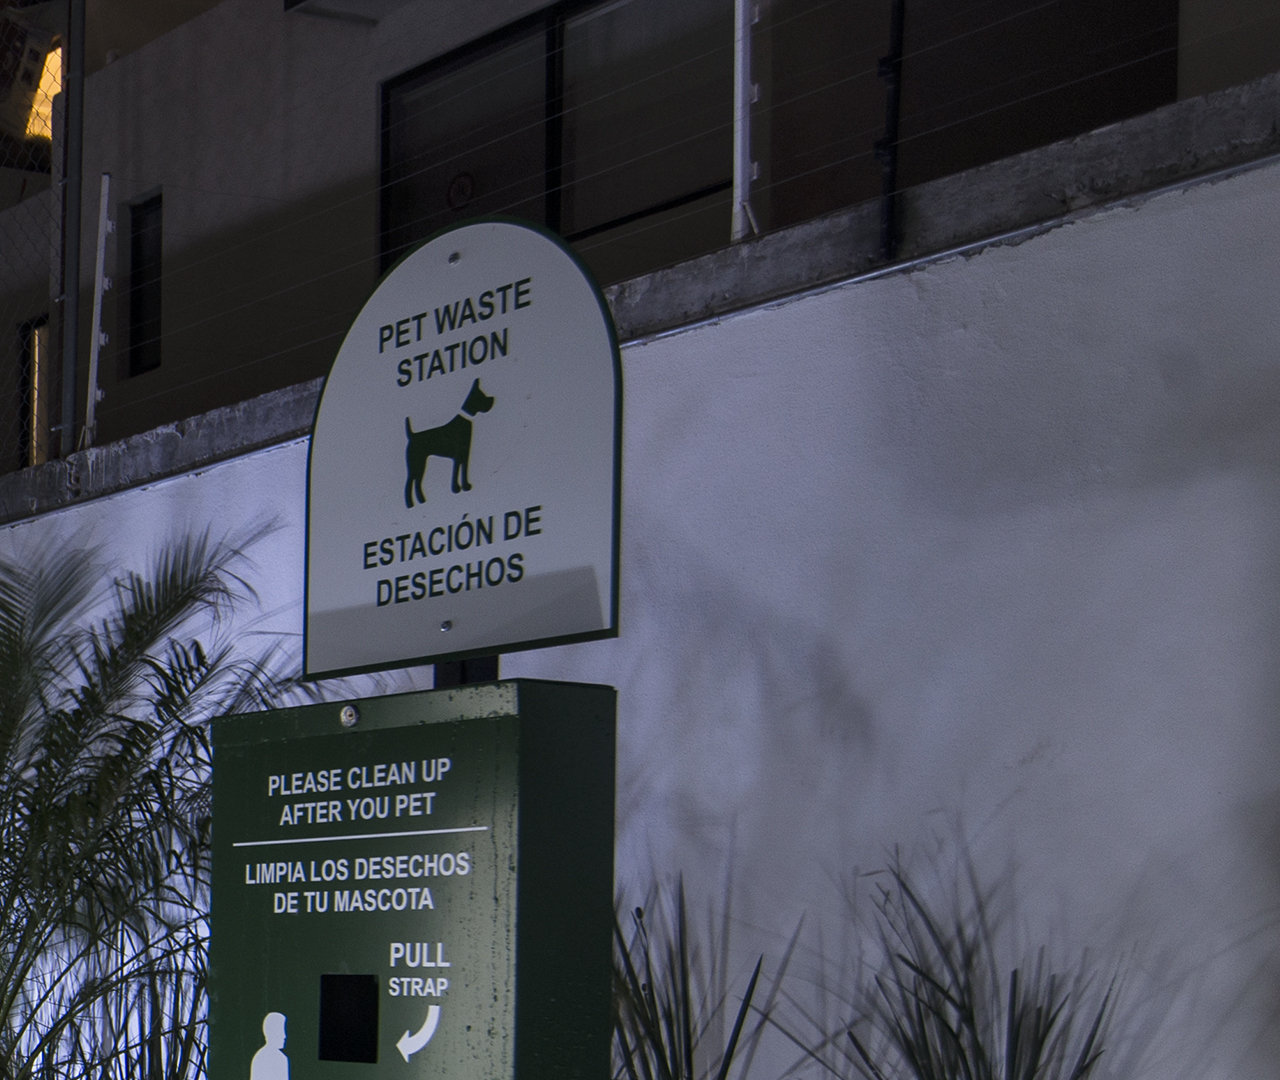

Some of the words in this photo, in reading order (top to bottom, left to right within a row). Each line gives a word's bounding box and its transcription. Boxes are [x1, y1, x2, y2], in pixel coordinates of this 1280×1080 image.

[379, 312, 428, 353] PET
[434, 277, 532, 334] WASTE
[396, 328, 509, 387] STATION
[363, 513, 494, 570] ESTACIÓN
[504, 505, 543, 541] DE
[377, 552, 524, 607] DESECHOS
[268, 769, 342, 796] PLEASE
[347, 761, 416, 789] CLEAN
[422, 757, 451, 782] UP
[279, 800, 341, 826] AFTER
[347, 795, 390, 820] YOU
[395, 792, 436, 817] PET
[245, 861, 306, 885] LIMPIA
[310, 857, 349, 883] LOS
[354, 852, 471, 880] DESECHOS
[273, 891, 299, 914] DE
[304, 890, 329, 913] TU
[333, 887, 434, 913] MASCOTA
[389, 942, 450, 968] PULL
[388, 975, 449, 997] STRAP
